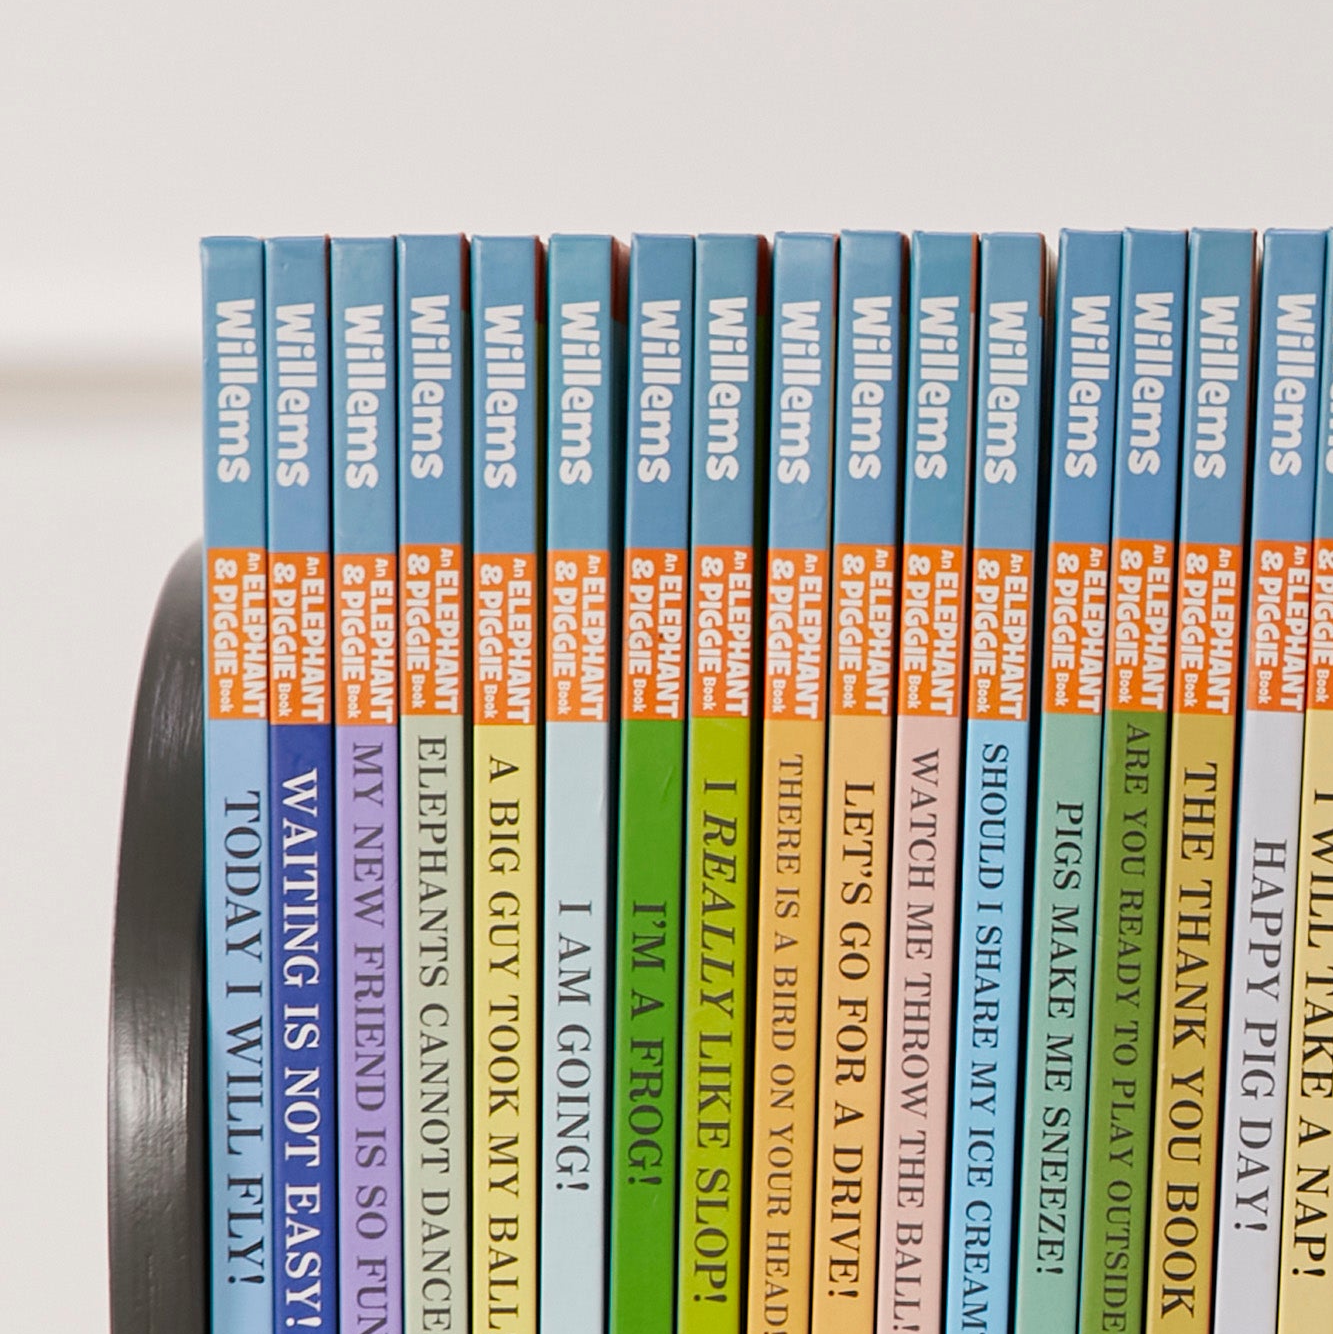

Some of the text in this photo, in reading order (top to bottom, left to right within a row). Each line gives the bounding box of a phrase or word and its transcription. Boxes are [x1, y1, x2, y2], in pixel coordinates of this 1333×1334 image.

[216, 298, 259, 483] Willems
[410, 294, 452, 479] Willems
[559, 300, 602, 485] Willems
[777, 300, 822, 485] Willems
[983, 300, 1029, 484] Willems
[1128, 292, 1174, 475] Willems
[477, 563, 504, 718] & PIGGIE Book
[507, 558, 532, 724] An ELEPHANT
[551, 560, 578, 715] & PIGGIE Book
[580, 554, 607, 721] An ELEPHANT
[352, 742, 384, 807] MY
[489, 755, 520, 783] A
[776, 754, 804, 875] THERE
[1124, 722, 1151, 795] ARE
[353, 824, 385, 927] NEW
[418, 737, 449, 988] ELEPHANTS
[488, 800, 521, 875] BIG
[1120, 808, 1148, 876] YOU
[488, 891, 521, 978] GUY
[774, 888, 800, 919] IS
[774, 931, 799, 953] A
[1115, 888, 1145, 1009] READY
[224, 790, 265, 1285] TODAY I WILL FLY!
[282, 768, 322, 1327] WAITING IS NOT EASY!
[353, 944, 386, 1112] FRIEND
[488, 994, 521, 1117] TOOK
[555, 902, 592, 1191] I AM GOING!
[771, 967, 798, 1052] BIRD
[1112, 1020, 1139, 1067] TO
[1234, 839, 1287, 1232] HAPPY PIG DAY!
[419, 1003, 451, 1174] CANNOT
[770, 1063, 795, 1111] ON
[1109, 1078, 1137, 1168] PLAY
[355, 1128, 387, 1168] IS
[488, 1133, 519, 1198] MY
[766, 1123, 794, 1218] YOUR
[355, 1185, 388, 1240] SO
